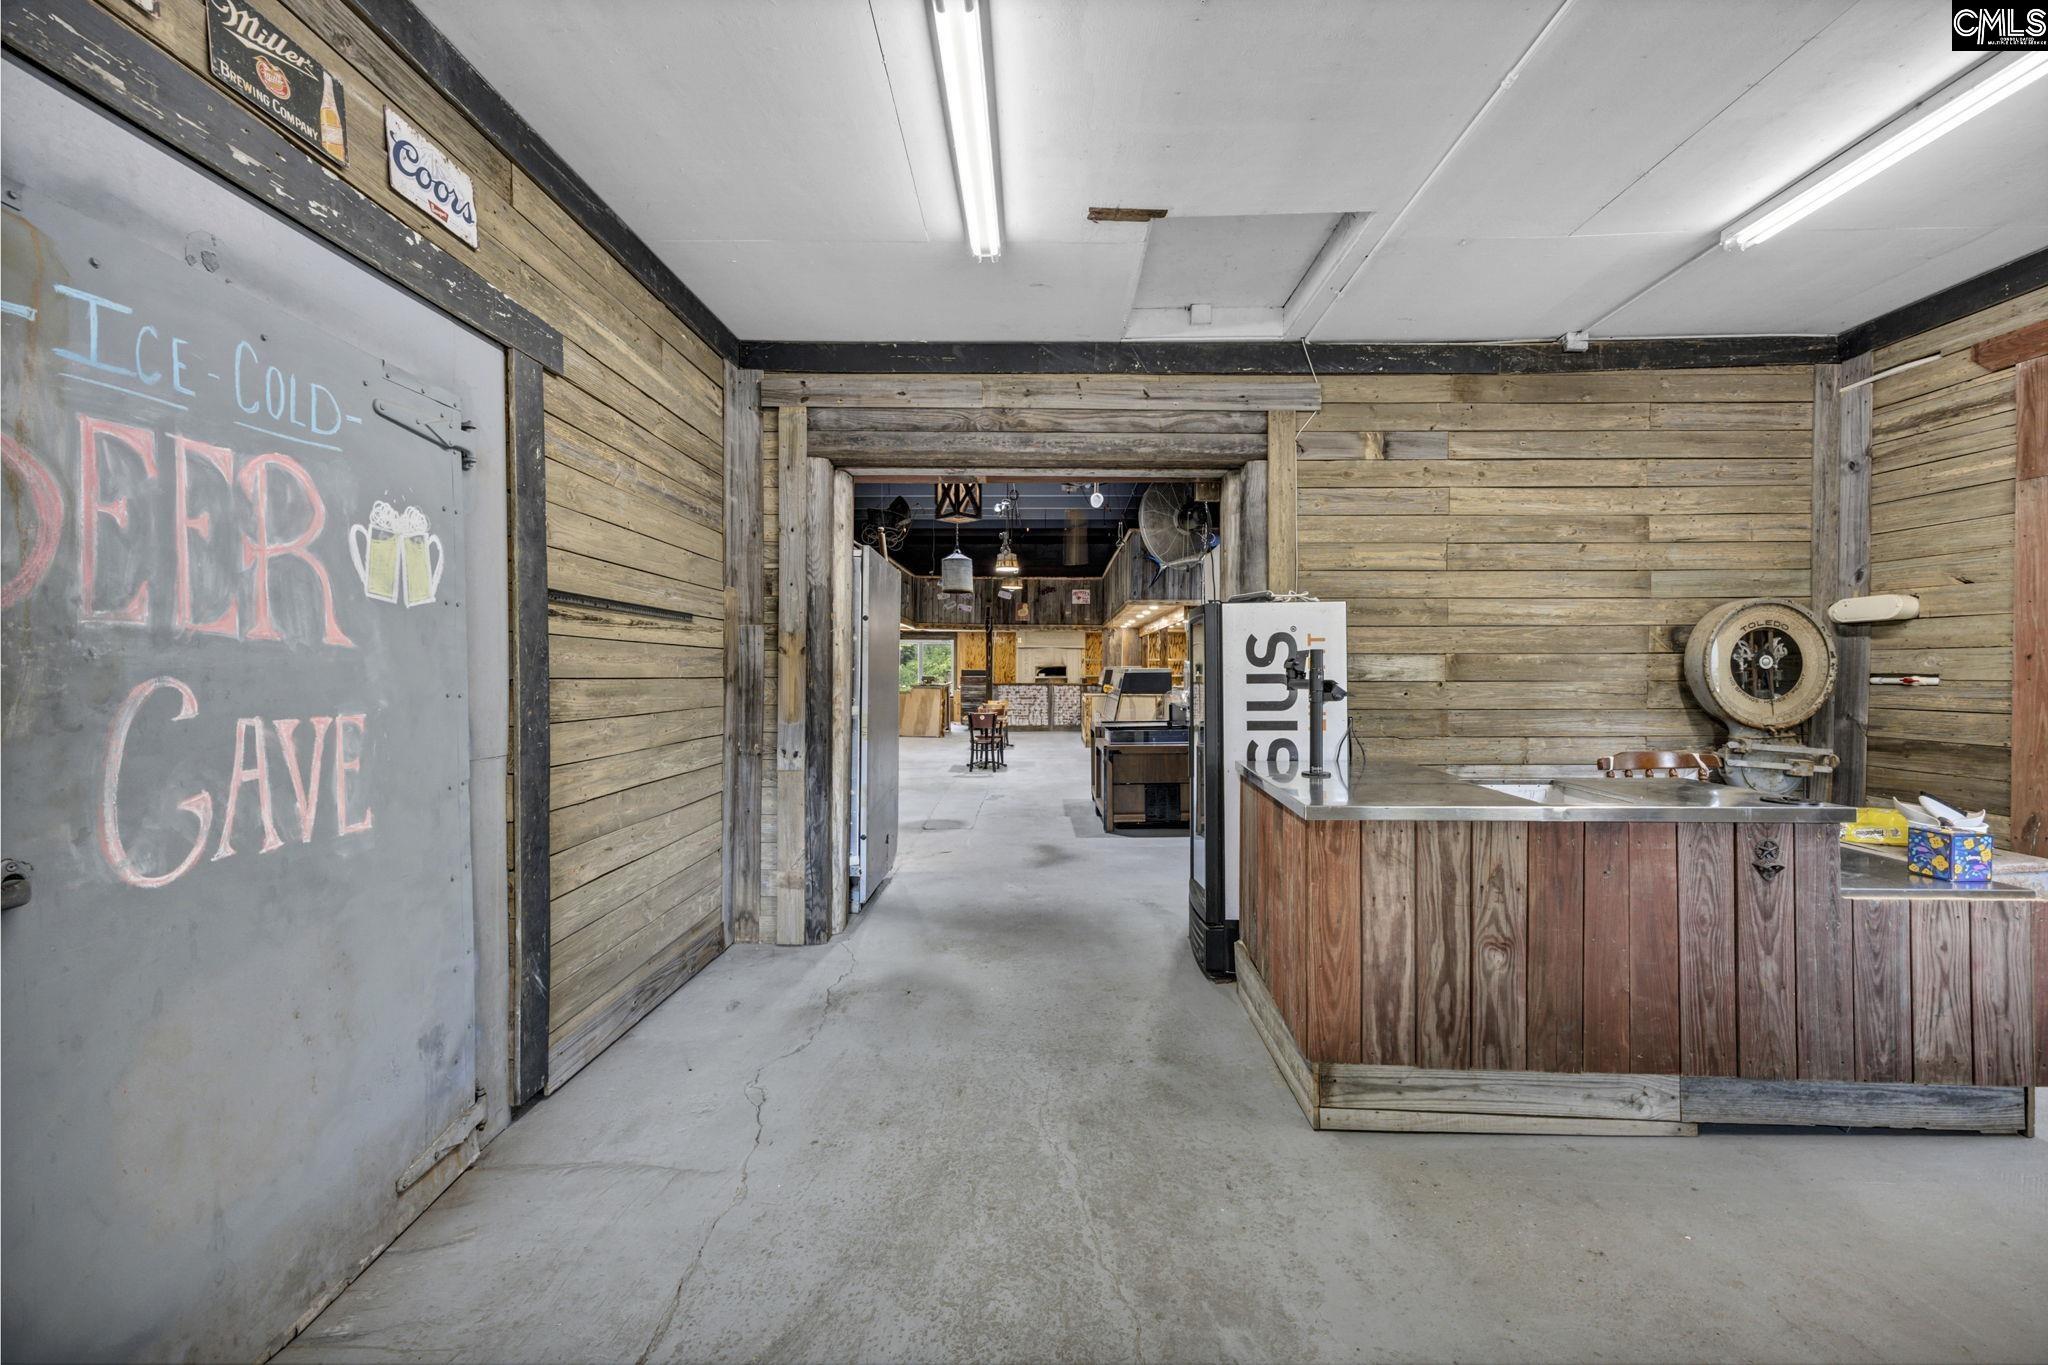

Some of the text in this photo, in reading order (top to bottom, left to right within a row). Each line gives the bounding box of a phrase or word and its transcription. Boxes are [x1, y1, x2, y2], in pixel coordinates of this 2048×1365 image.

[211, 0, 311, 68] Miller
[218, 60, 319, 142] BREWING COMPANY
[390, 130, 475, 224] Coors
[1740, 619, 1790, 632] TOLEDO
